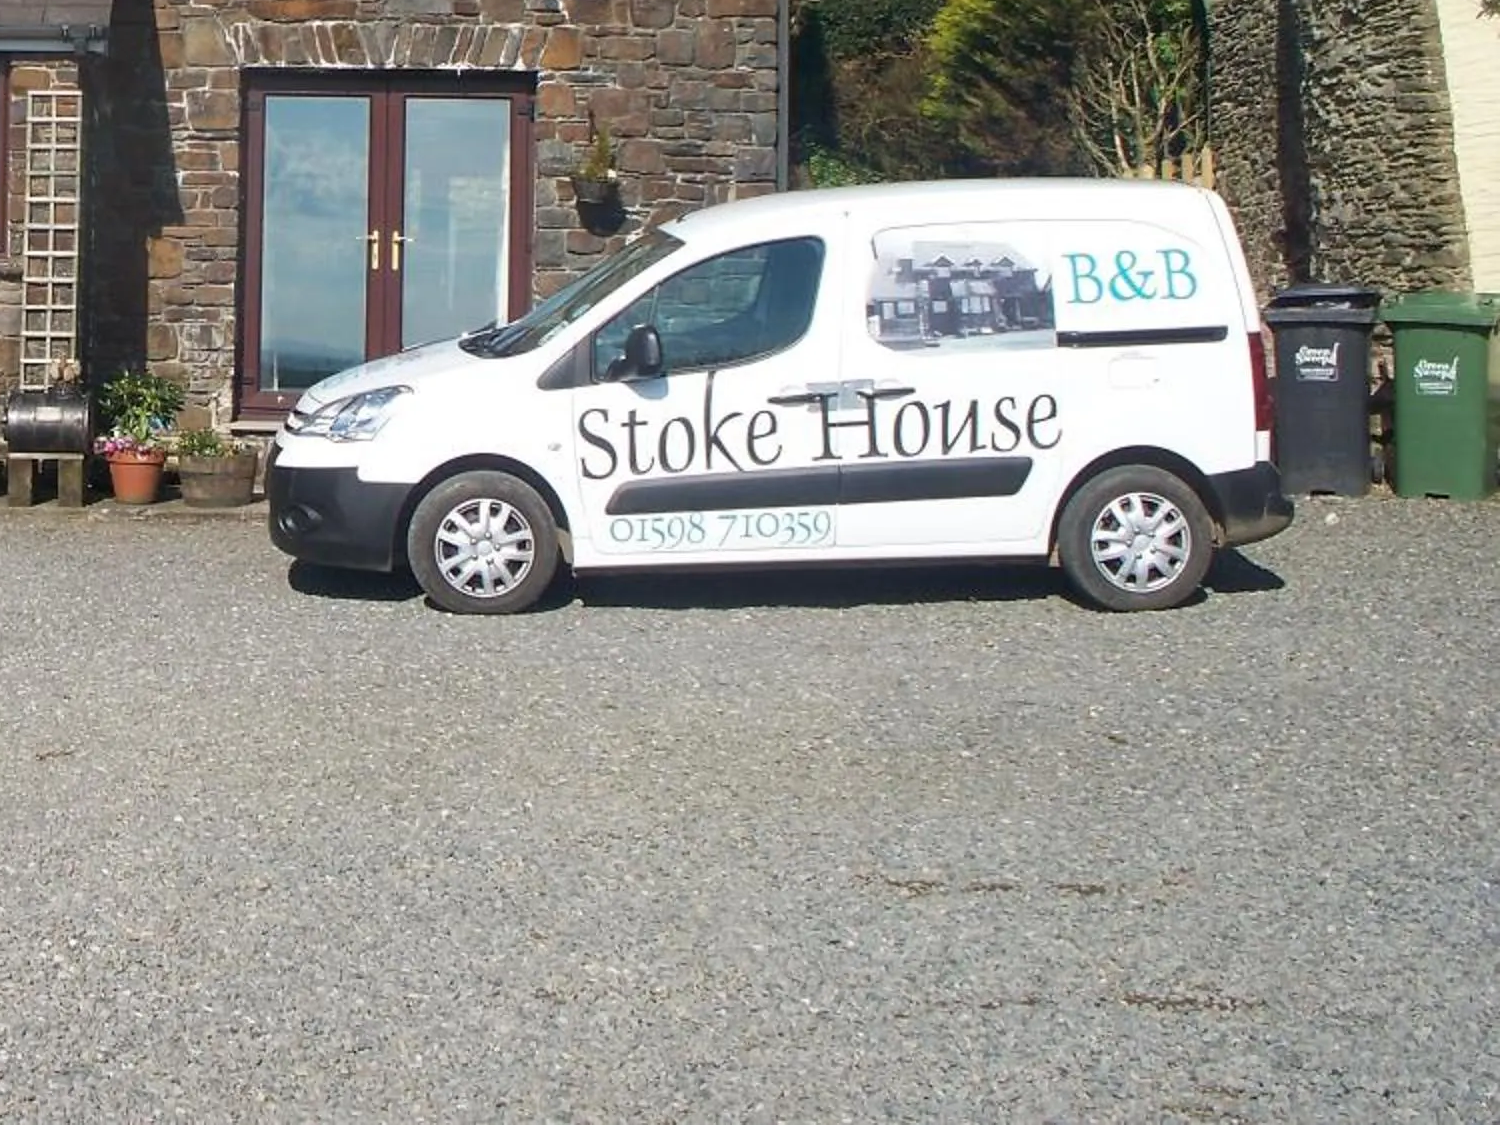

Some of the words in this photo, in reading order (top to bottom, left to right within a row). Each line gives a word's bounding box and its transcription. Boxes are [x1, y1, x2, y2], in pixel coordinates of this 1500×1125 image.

[1060, 247, 1198, 305] B&B
[577, 370, 784, 481] Stoke
[811, 392, 1063, 462] House
[609, 512, 707, 550] 01598
[717, 510, 832, 547] 710359
